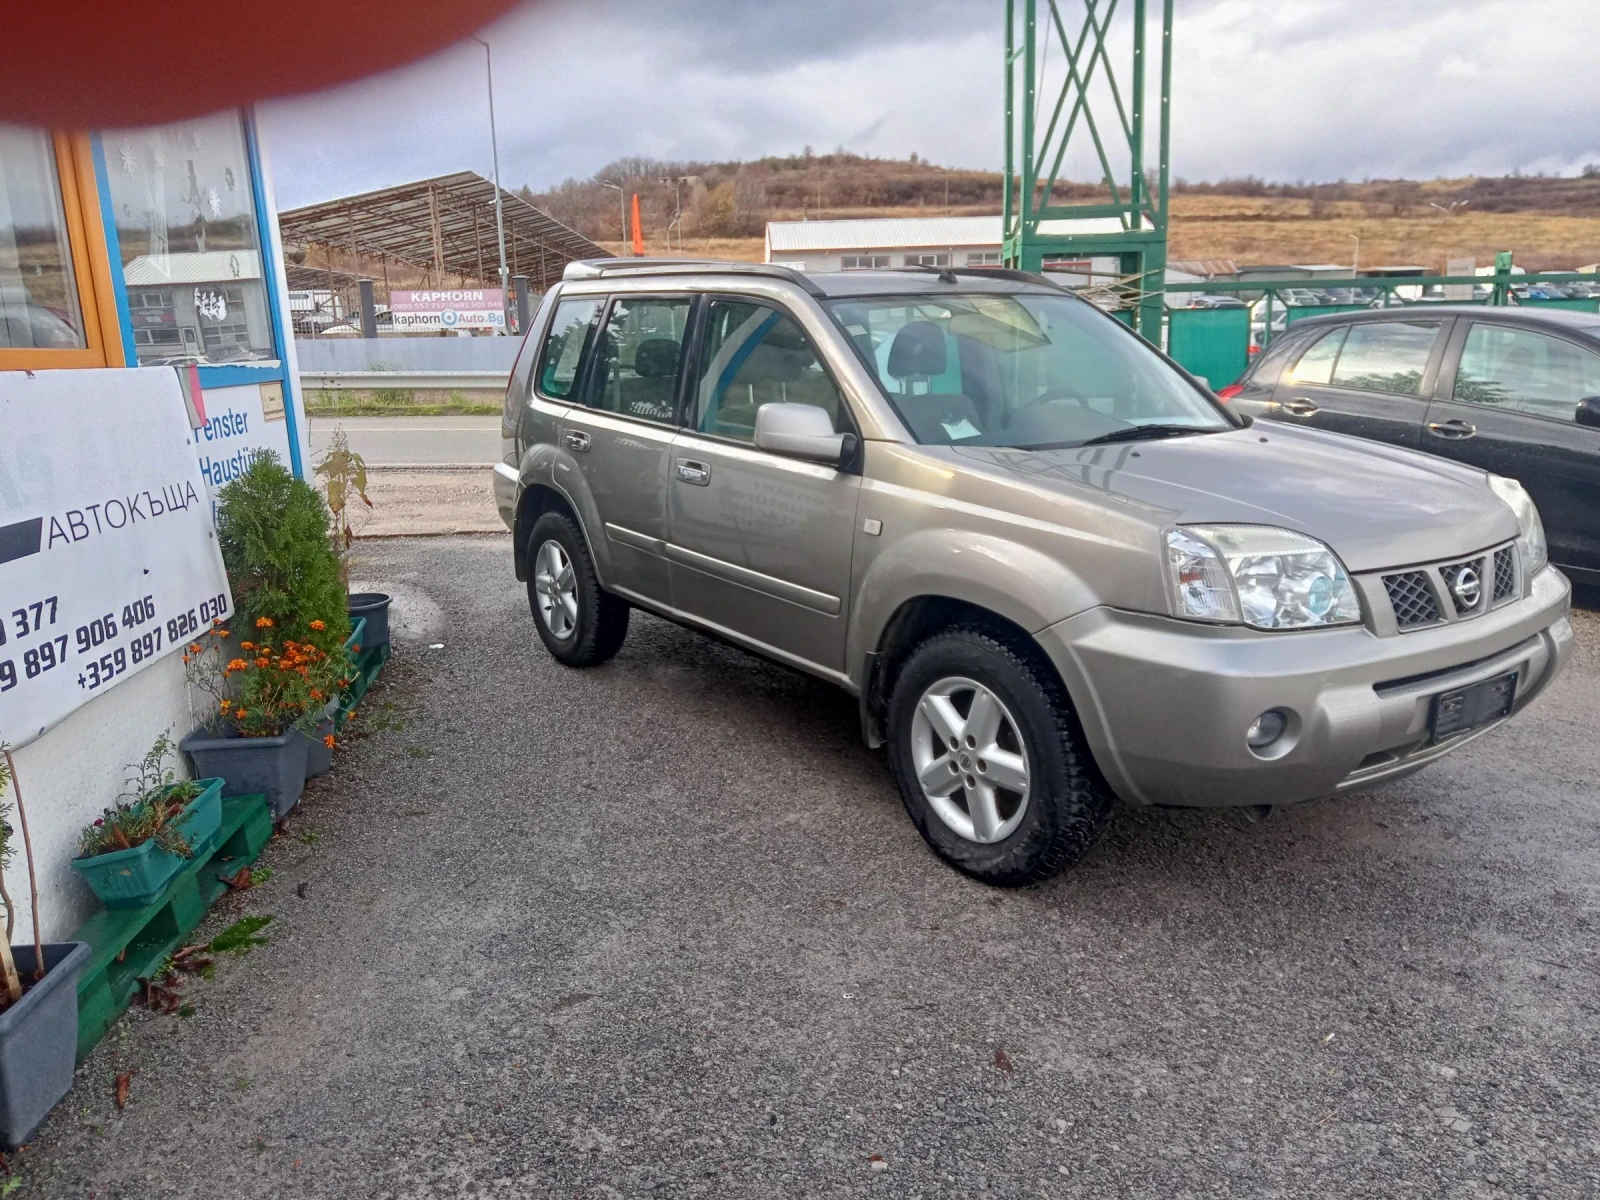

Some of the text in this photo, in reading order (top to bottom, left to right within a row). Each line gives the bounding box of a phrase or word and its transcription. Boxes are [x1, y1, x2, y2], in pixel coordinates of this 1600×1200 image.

[394, 314, 440, 327] kaphorn
[411, 290, 484, 302] KAPHORN
[48, 480, 199, 549] АВТОКЪЩА
[12, 596, 58, 639] 377
[24, 634, 68, 679] 897
[76, 613, 118, 654] 906
[122, 595, 155, 629] 406
[78, 593, 227, 690] +359 897 826 030
